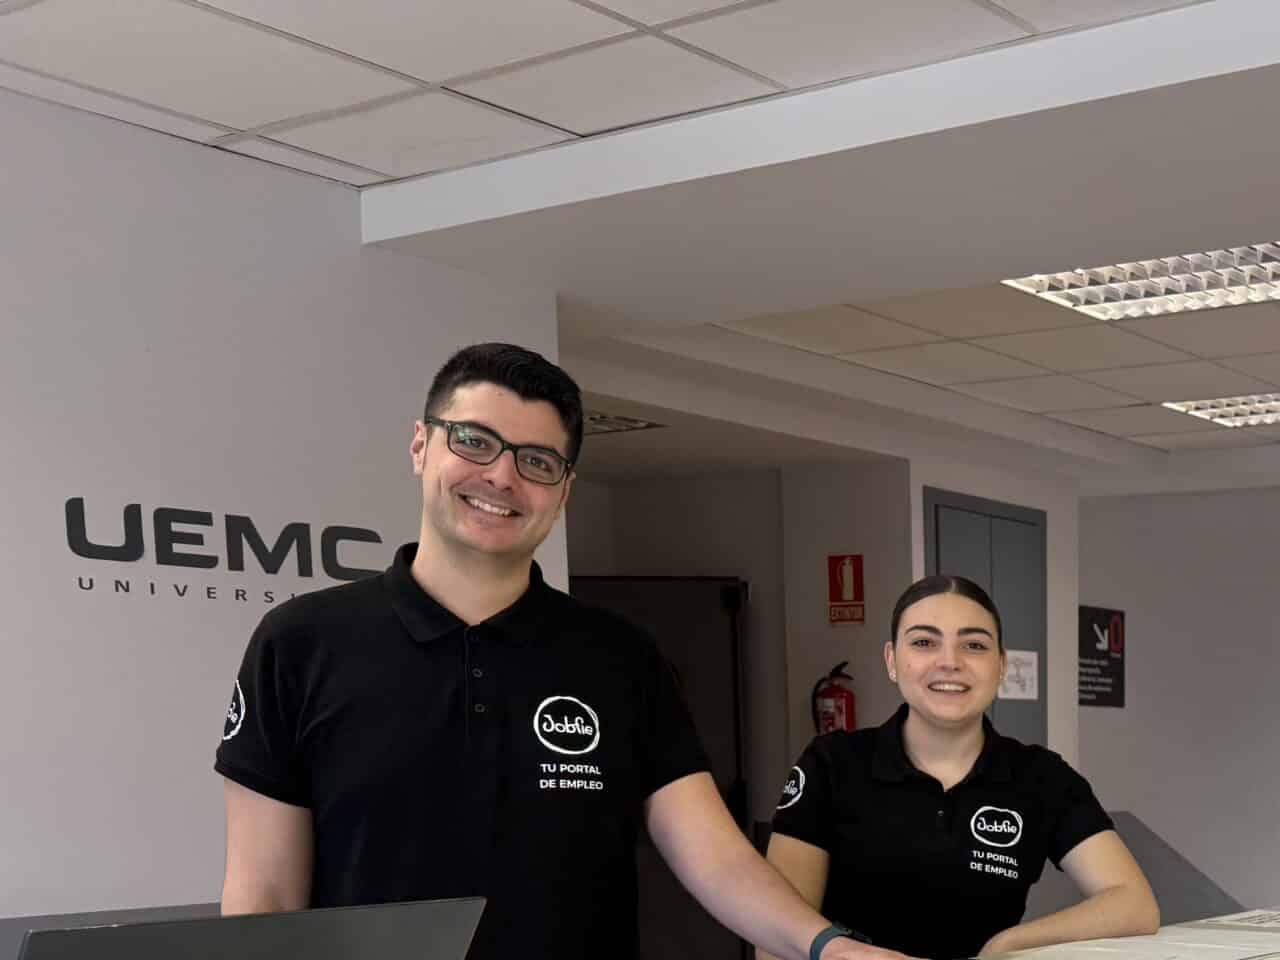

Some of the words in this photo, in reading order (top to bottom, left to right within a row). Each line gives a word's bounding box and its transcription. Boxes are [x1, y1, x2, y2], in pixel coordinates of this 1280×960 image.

[65, 497, 384, 581] UEMC
[78, 576, 296, 603] UNIVERS
[540, 763, 557, 773] TU
[560, 763, 601, 775] PORTAL
[539, 779, 557, 789] DE
[559, 779, 604, 790] EMPLEO
[972, 850, 984, 858] TU
[986, 852, 1018, 866] PORTAL
[970, 862, 982, 871] DE
[985, 864, 1018, 879] EMPLEO
